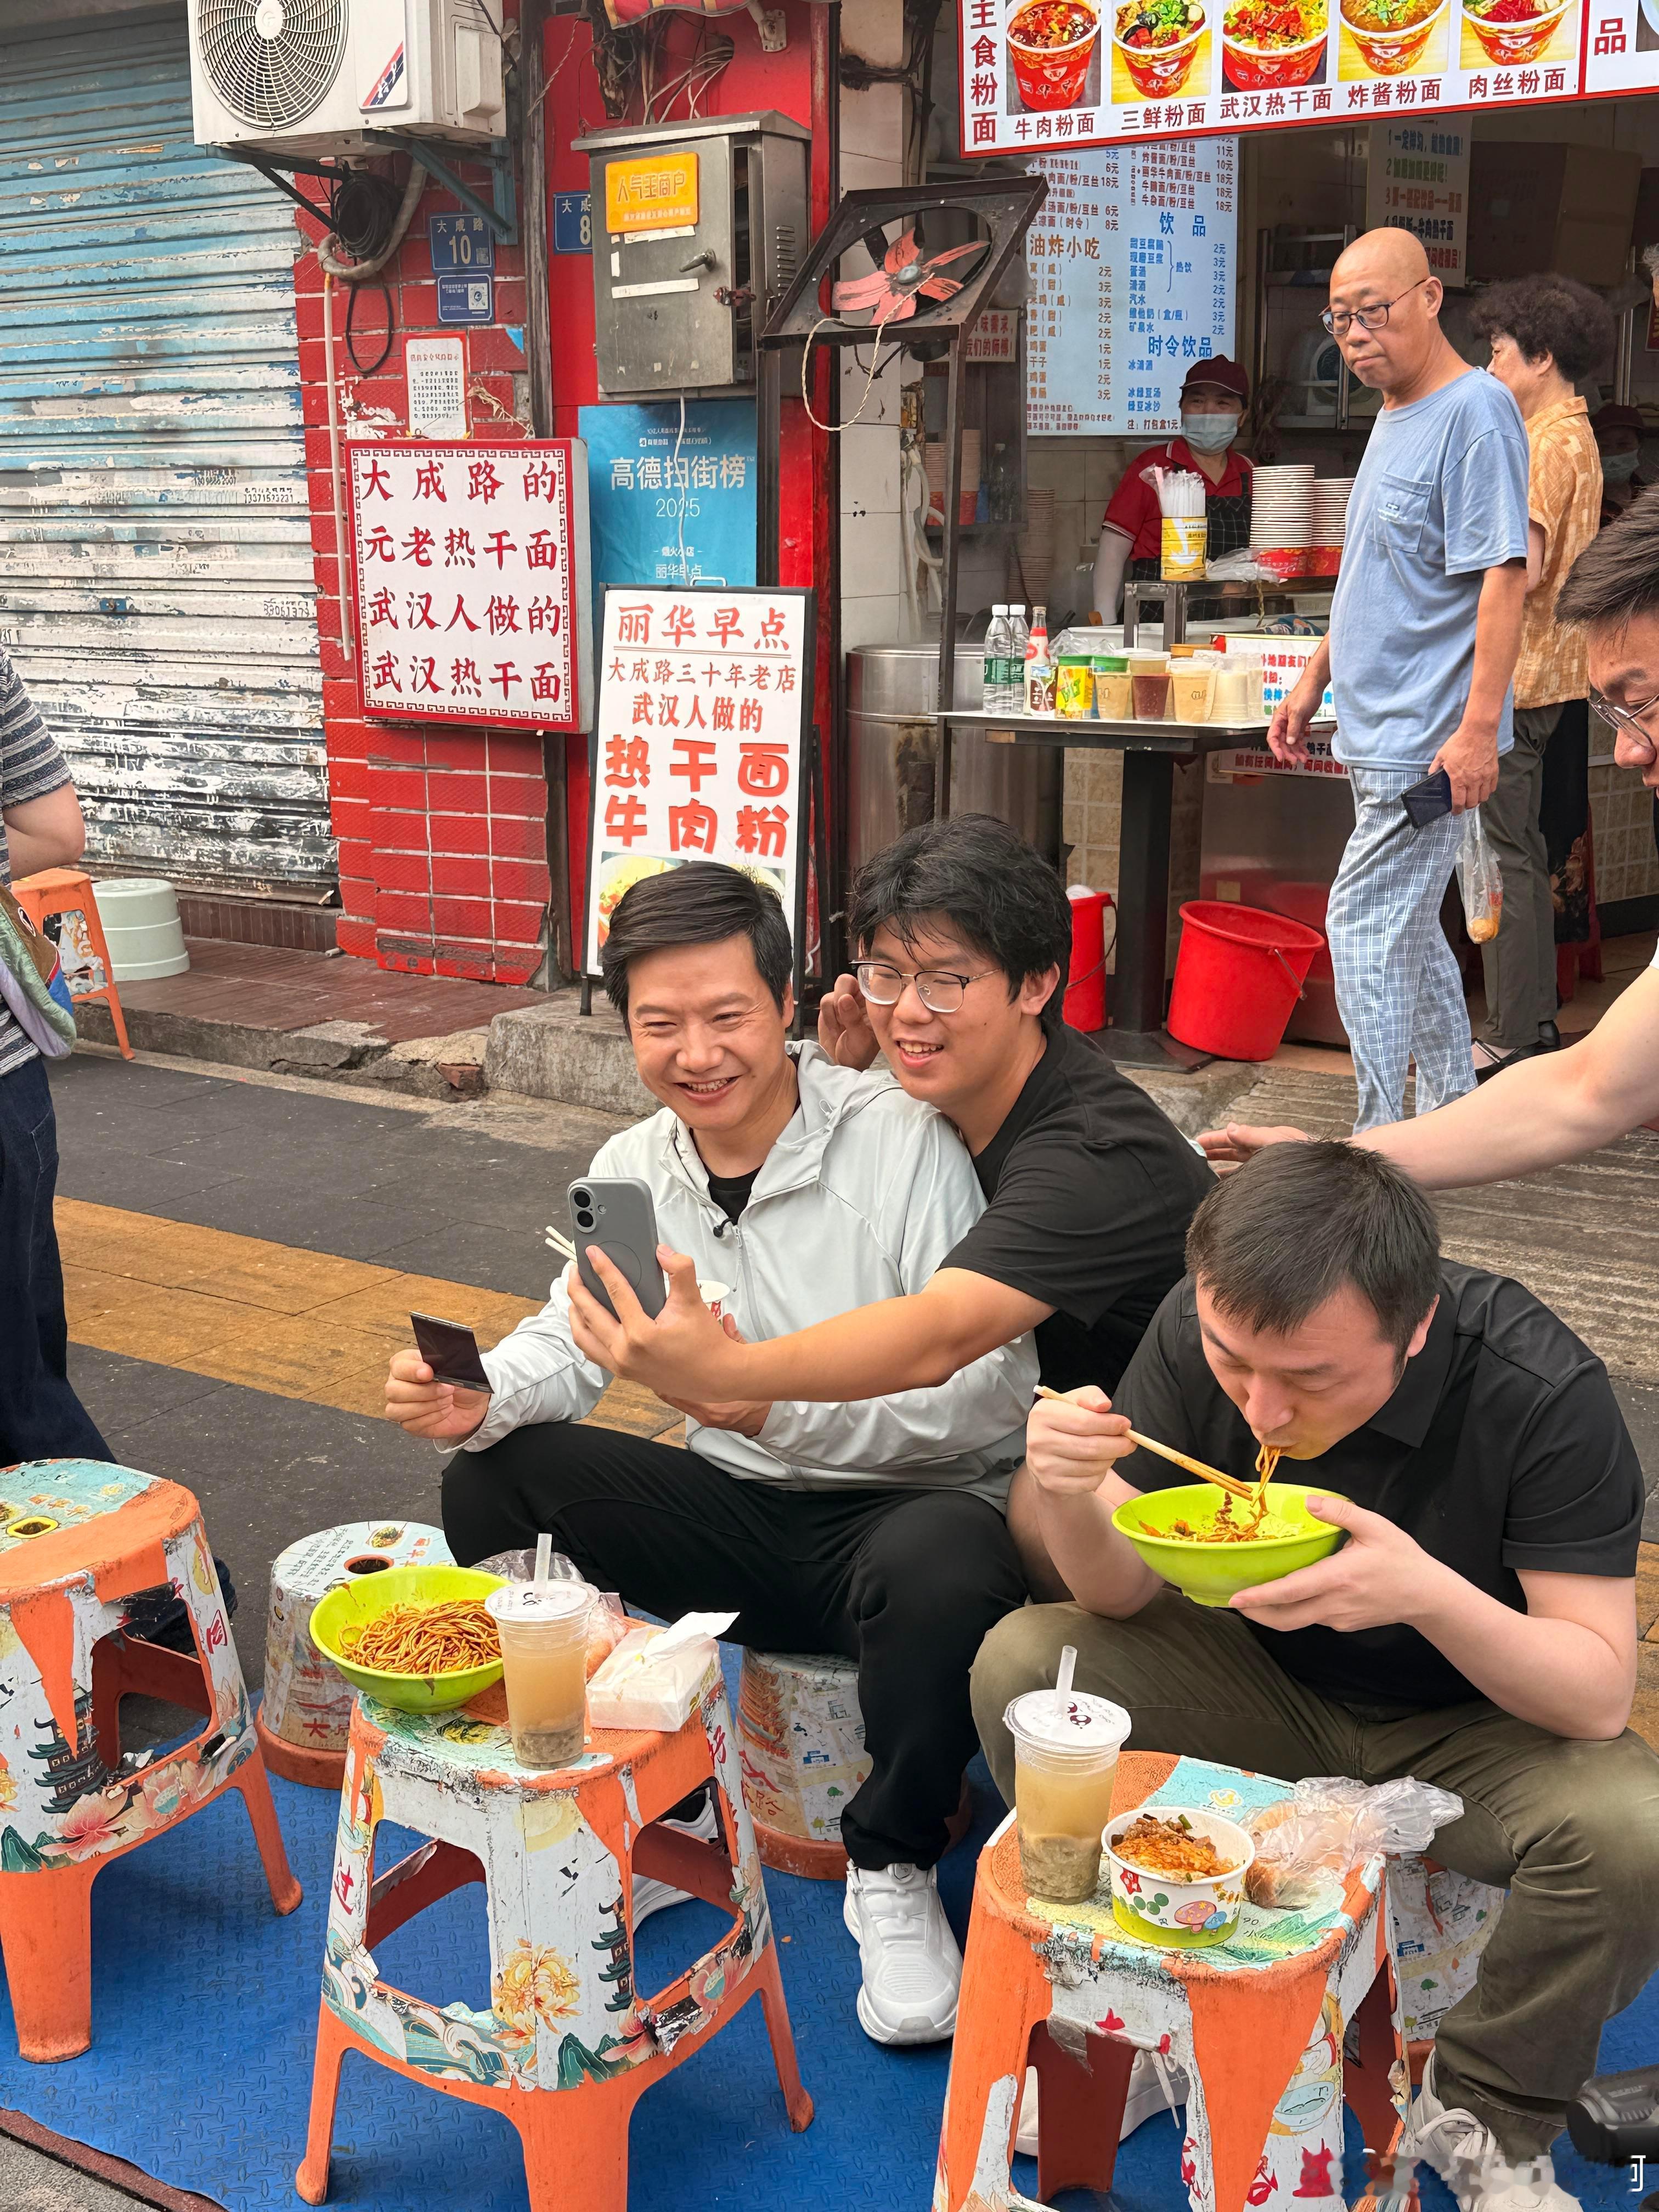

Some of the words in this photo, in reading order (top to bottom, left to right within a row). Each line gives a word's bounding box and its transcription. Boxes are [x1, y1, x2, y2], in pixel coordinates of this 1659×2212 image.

[1595, 18, 1627, 55] 品
[970, 0, 998, 144] 主食粉面
[1469, 67, 1566, 98] 肉丝粉面
[1220, 89, 1333, 119] 武汉热干面
[1347, 78, 1442, 108] 炸酱粉面
[1014, 112, 1095, 140] 牛肉粉面
[1121, 103, 1206, 131] 三鲜粉面
[1159, 211, 1206, 237] 饮品
[448, 234, 471, 264] 10
[1030, 234, 1101, 260] 油炸小吃
[1148, 335, 1212, 358] 时令饮品
[361, 459, 557, 505] 大成路的
[610, 454, 746, 490] 高德扫街榜
[656, 498, 700, 517] 2025
[364, 525, 557, 571] 元老热干面
[368, 586, 561, 637] 武汉人做的
[618, 603, 790, 651] 丽华早点
[371, 650, 562, 703] 武汉热干面
[607, 656, 797, 693] 大成路三十年老店
[632, 691, 764, 733] 武汉人做的
[604, 733, 789, 798] 热干面
[604, 794, 790, 859] 牛肉粉
